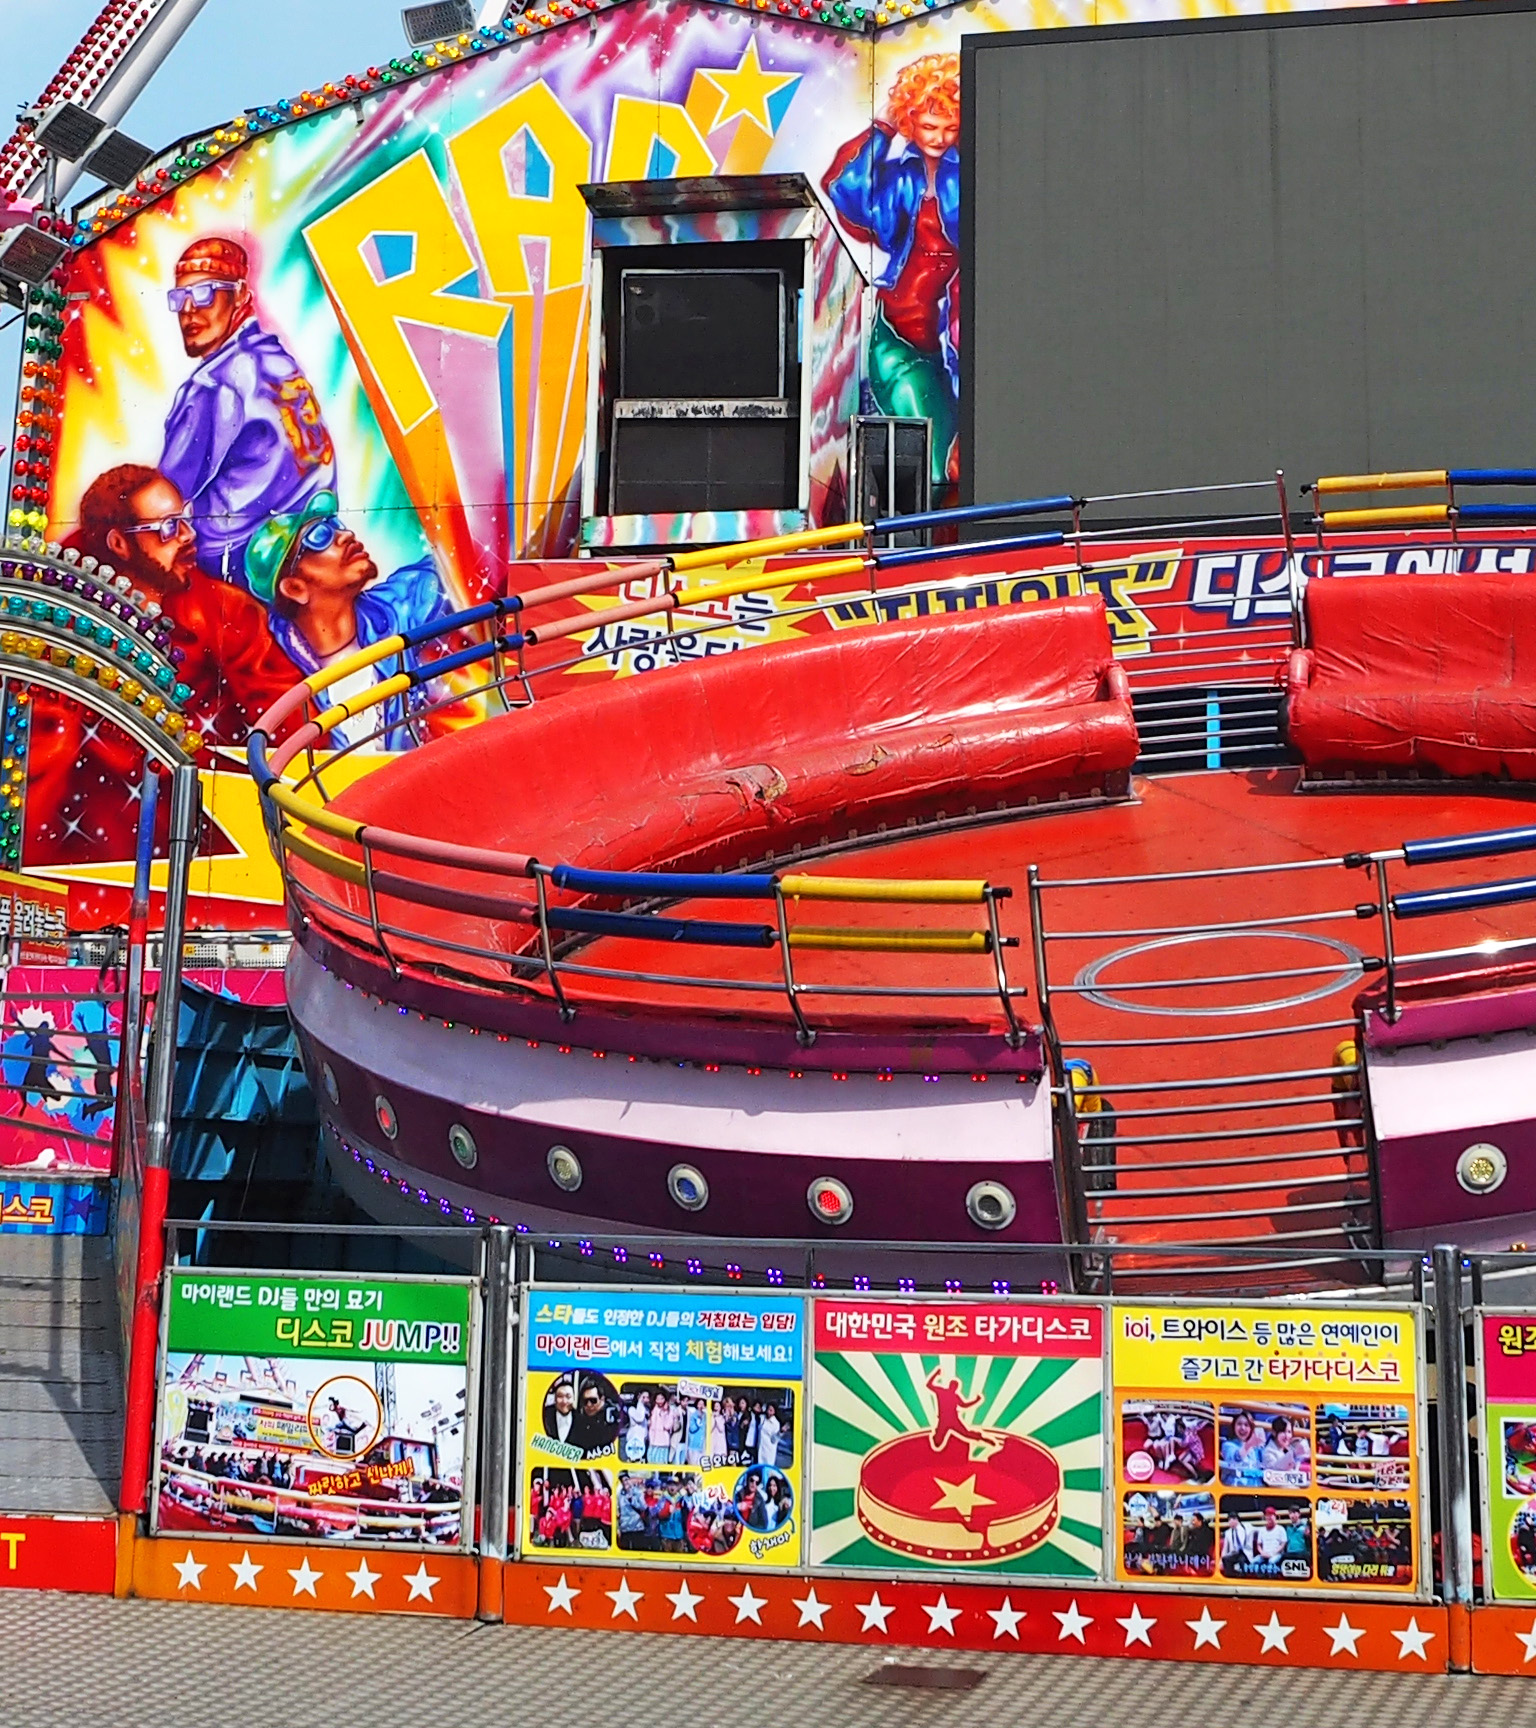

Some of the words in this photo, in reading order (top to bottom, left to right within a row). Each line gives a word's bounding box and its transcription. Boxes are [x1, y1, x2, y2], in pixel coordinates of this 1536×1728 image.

[182, 1283, 252, 1308] 마이랜드
[258, 1285, 298, 1310] DJ들
[304, 1287, 341, 1312] 만의
[344, 1289, 383, 1312] 묘기
[276, 1317, 354, 1349] 디스코
[360, 1319, 461, 1353] JUMP!!
[697, 1310, 757, 1330] 거침없는
[760, 1311, 796, 1332] 입담!
[825, 1310, 916, 1340] 대한민국
[922, 1313, 969, 1342] 원조
[974, 1315, 1092, 1344] 타가디스코
[1161, 1319, 1248, 1341] 트와이스
[1252, 1321, 1272, 1345] 등
[1277, 1322, 1316, 1346] 많은
[1321, 1322, 1399, 1347] 연예인이
[536, 1333, 644, 1360] 마이랜드에서
[648, 1341, 680, 1363] 직접
[685, 1339, 793, 1365] 체험해보세요!
[1181, 1357, 1239, 1381] 즐기고
[1244, 1359, 1264, 1382] 간
[1269, 1359, 1400, 1383] 타가다디스코
[531, 1434, 583, 1463] HANGOVER
[586, 1443, 618, 1462] 싸이
[699, 1450, 754, 1473] 트와이스
[308, 1471, 362, 1496] 짜릿하고
[366, 1456, 414, 1485] 신나게!
[1284, 1561, 1306, 1572] SNL
